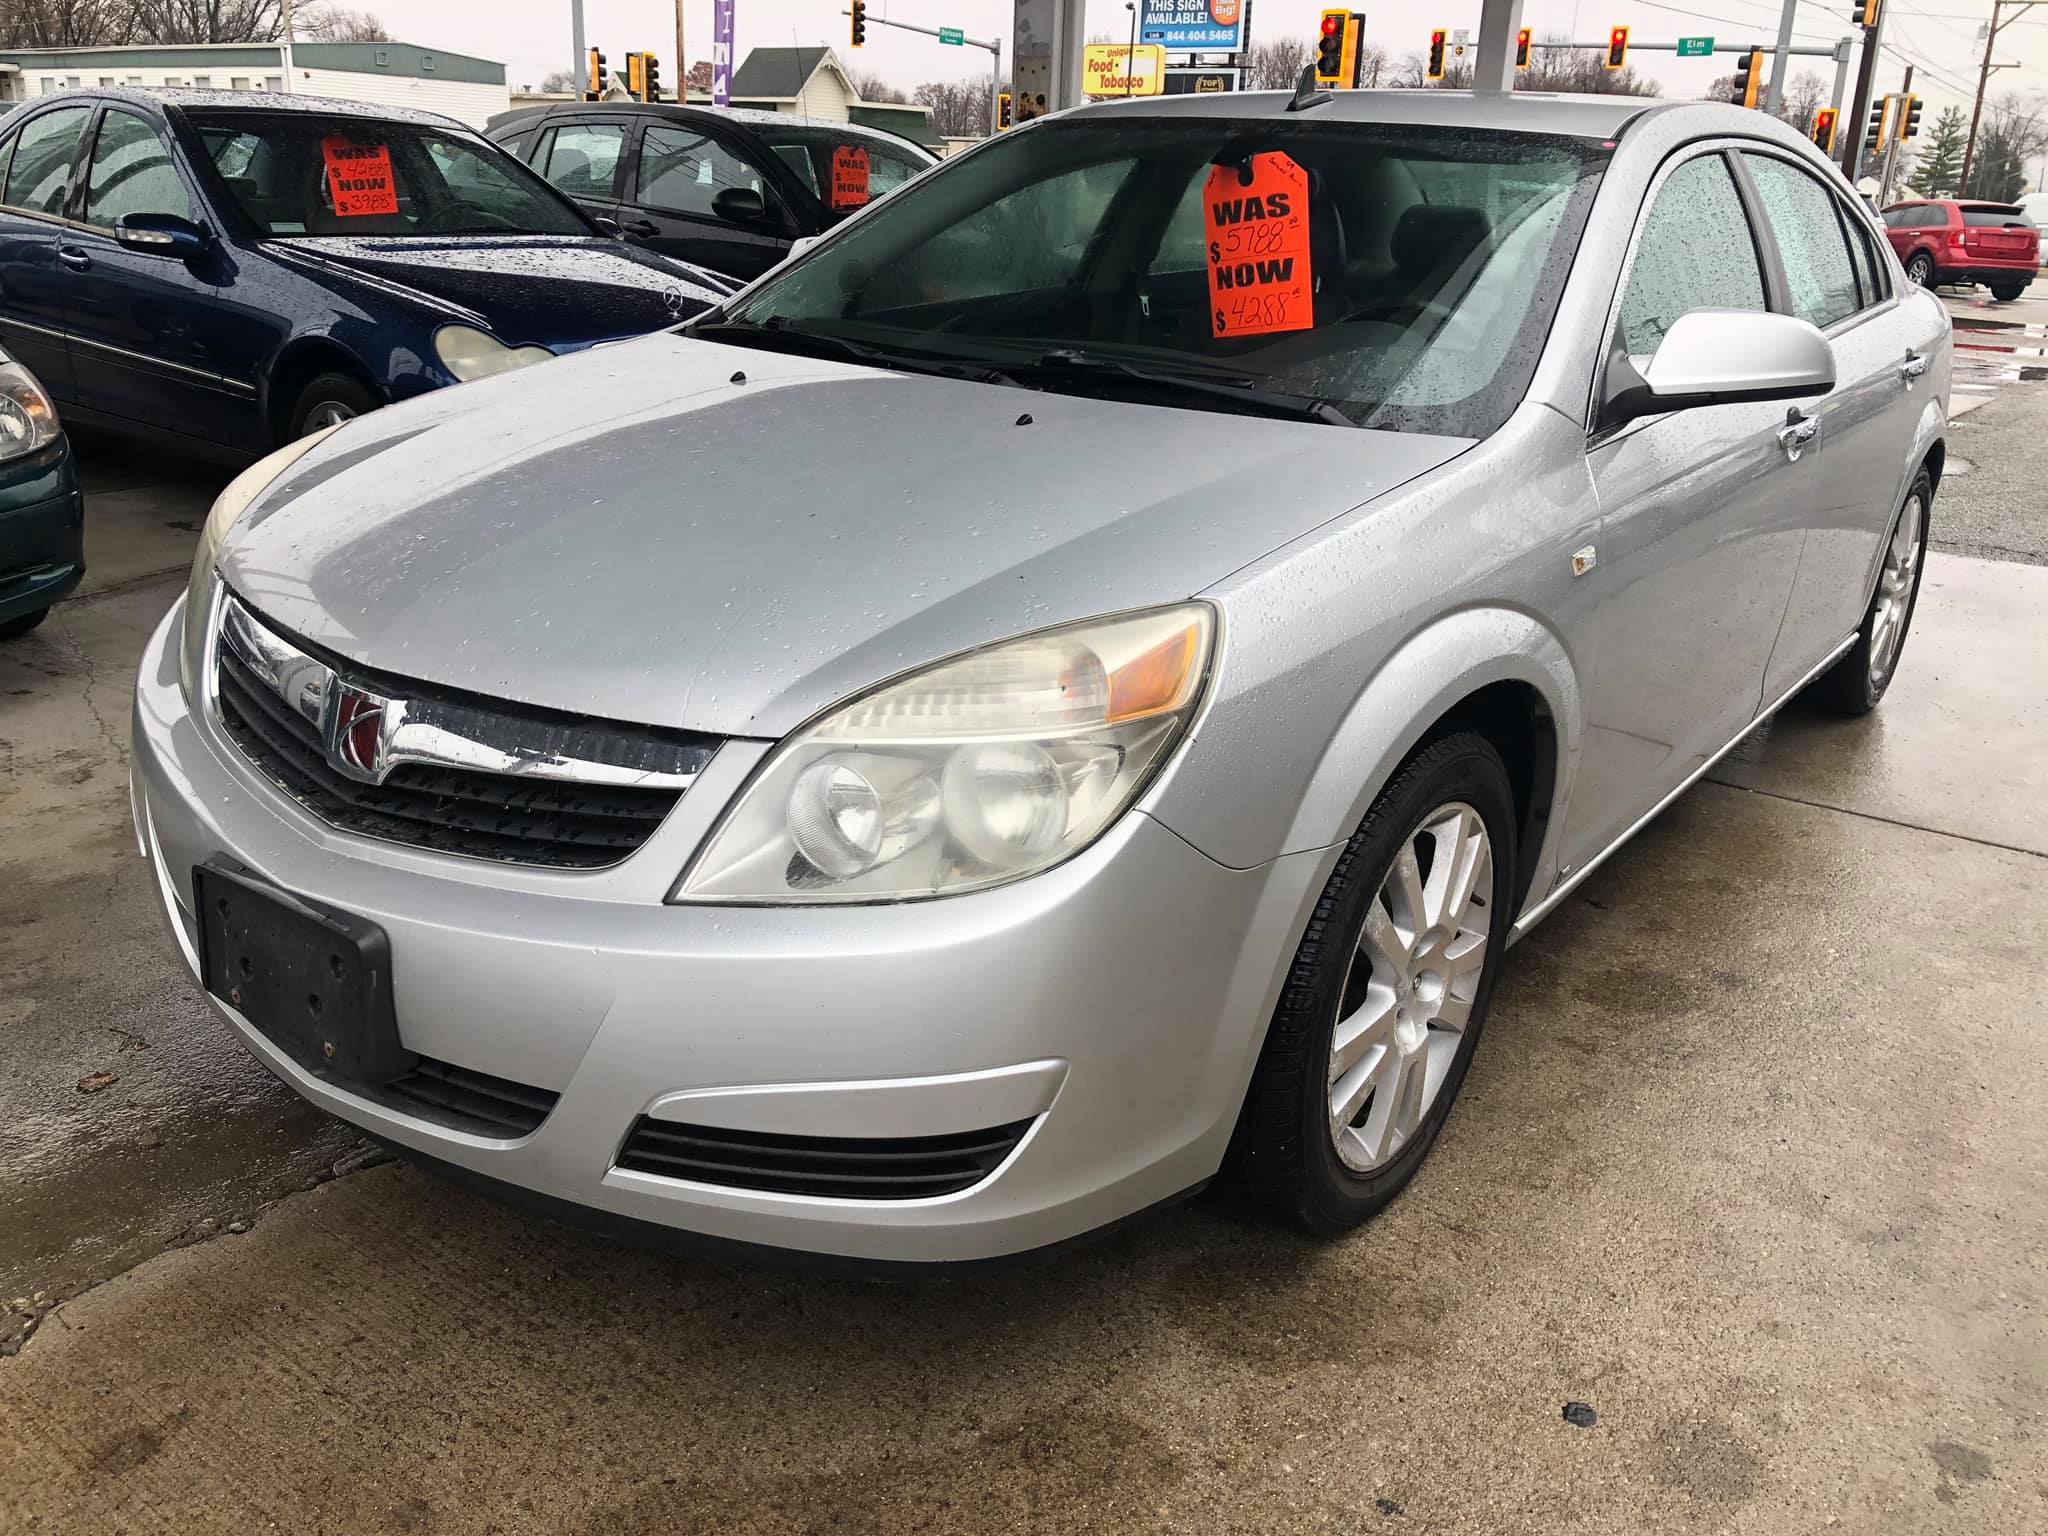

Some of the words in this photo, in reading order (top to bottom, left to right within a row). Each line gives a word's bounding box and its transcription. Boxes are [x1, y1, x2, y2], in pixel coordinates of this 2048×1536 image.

[1149, 0, 1174, 11] THIS
[1177, 0, 1204, 11] SIGN
[1145, 12, 1208, 25] AVAILABLE!
[1167, 31, 1185, 40] 844
[1187, 31, 1206, 40] 404
[1209, 30, 1234, 40] 5465
[1687, 39, 1704, 48] Elm
[1107, 48, 1132, 57] Uniqu
[1088, 58, 1114, 72] Food
[1100, 74, 1144, 88] Tobacco
[1202, 79, 1218, 87] TOP
[332, 147, 380, 160] WAS
[839, 158, 865, 169] WAS
[338, 178, 386, 191] NOW
[838, 183, 865, 193] NOW
[1212, 193, 1290, 227] WAS
[1216, 257, 1294, 290] NOW
